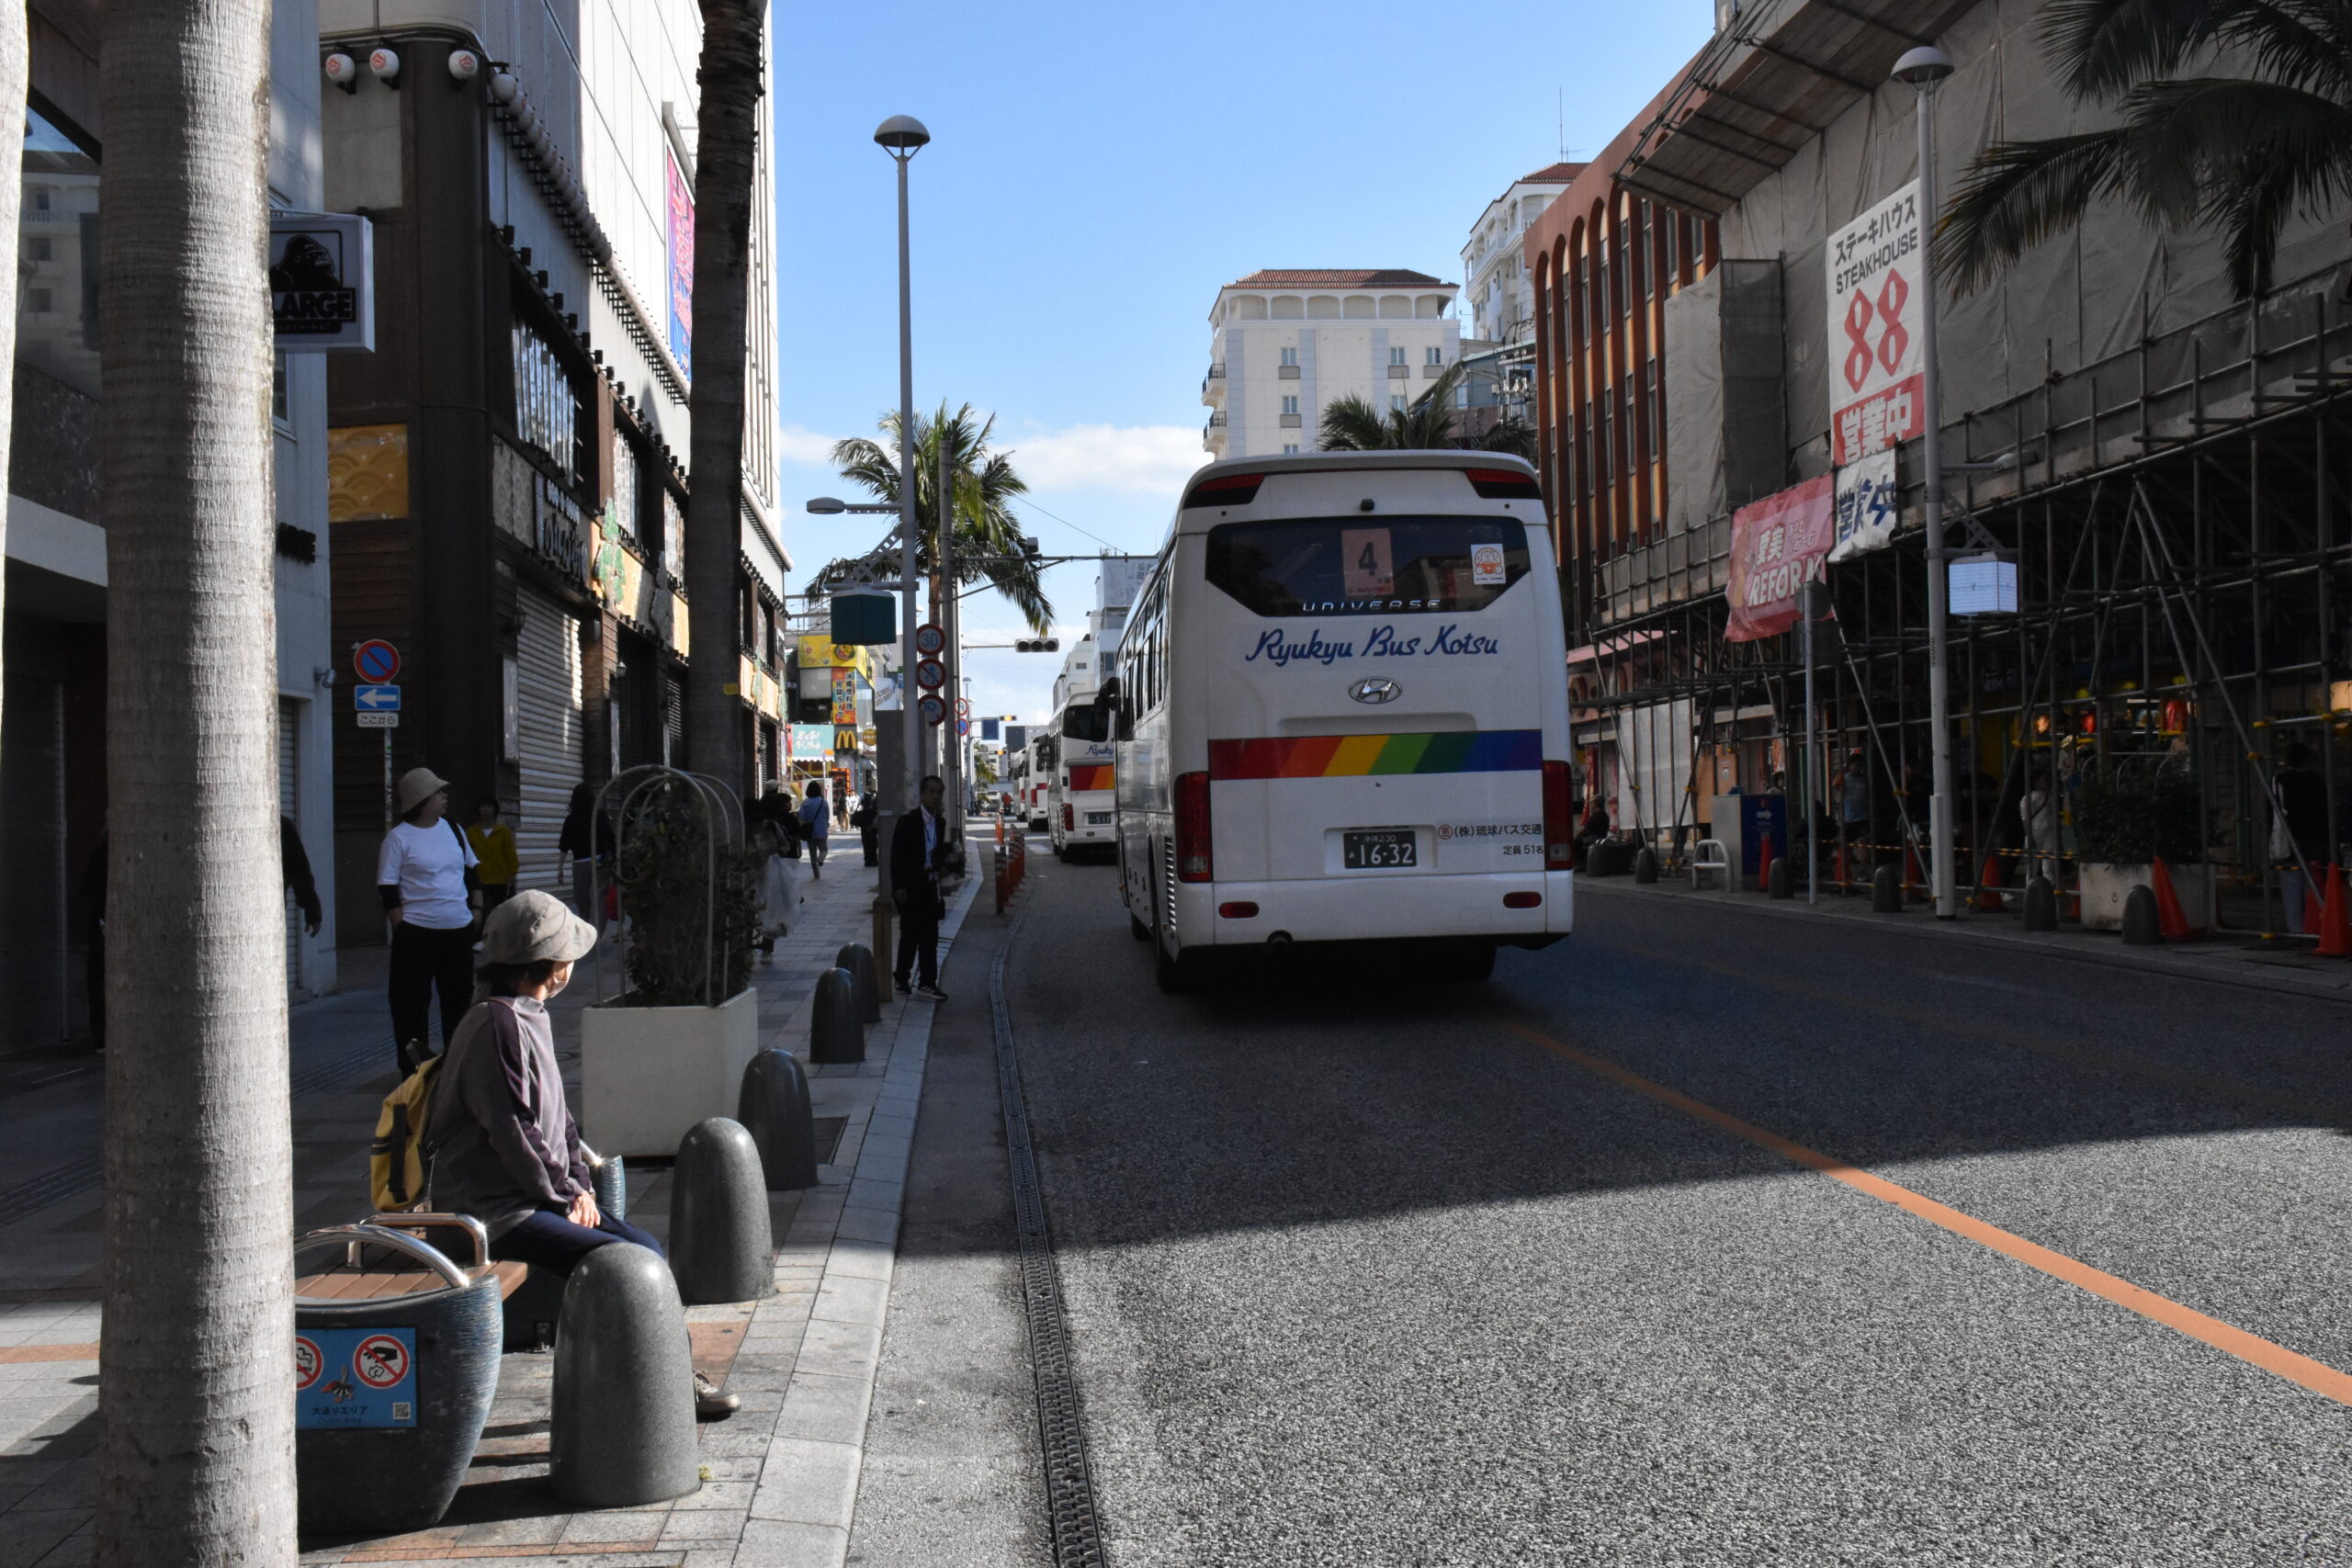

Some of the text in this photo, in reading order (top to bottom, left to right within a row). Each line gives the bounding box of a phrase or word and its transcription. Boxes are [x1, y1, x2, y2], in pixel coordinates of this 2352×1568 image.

[1835, 194, 1916, 266] ステーキハウス
[1836, 227, 1917, 294] STEAKHOUSE
[1844, 267, 1908, 393] 88
[1841, 387, 1913, 462] 営業中
[1358, 542, 1377, 576] 4
[1302, 599, 1441, 612] UNIVERSE
[921, 633, 939, 648] 30
[1245, 624, 1498, 667] Ryukyu Bus Kotsu
[359, 716, 395, 725] ここから
[1454, 823, 1544, 838] (株)琉球バス交通
[1361, 843, 1413, 865] 16-32
